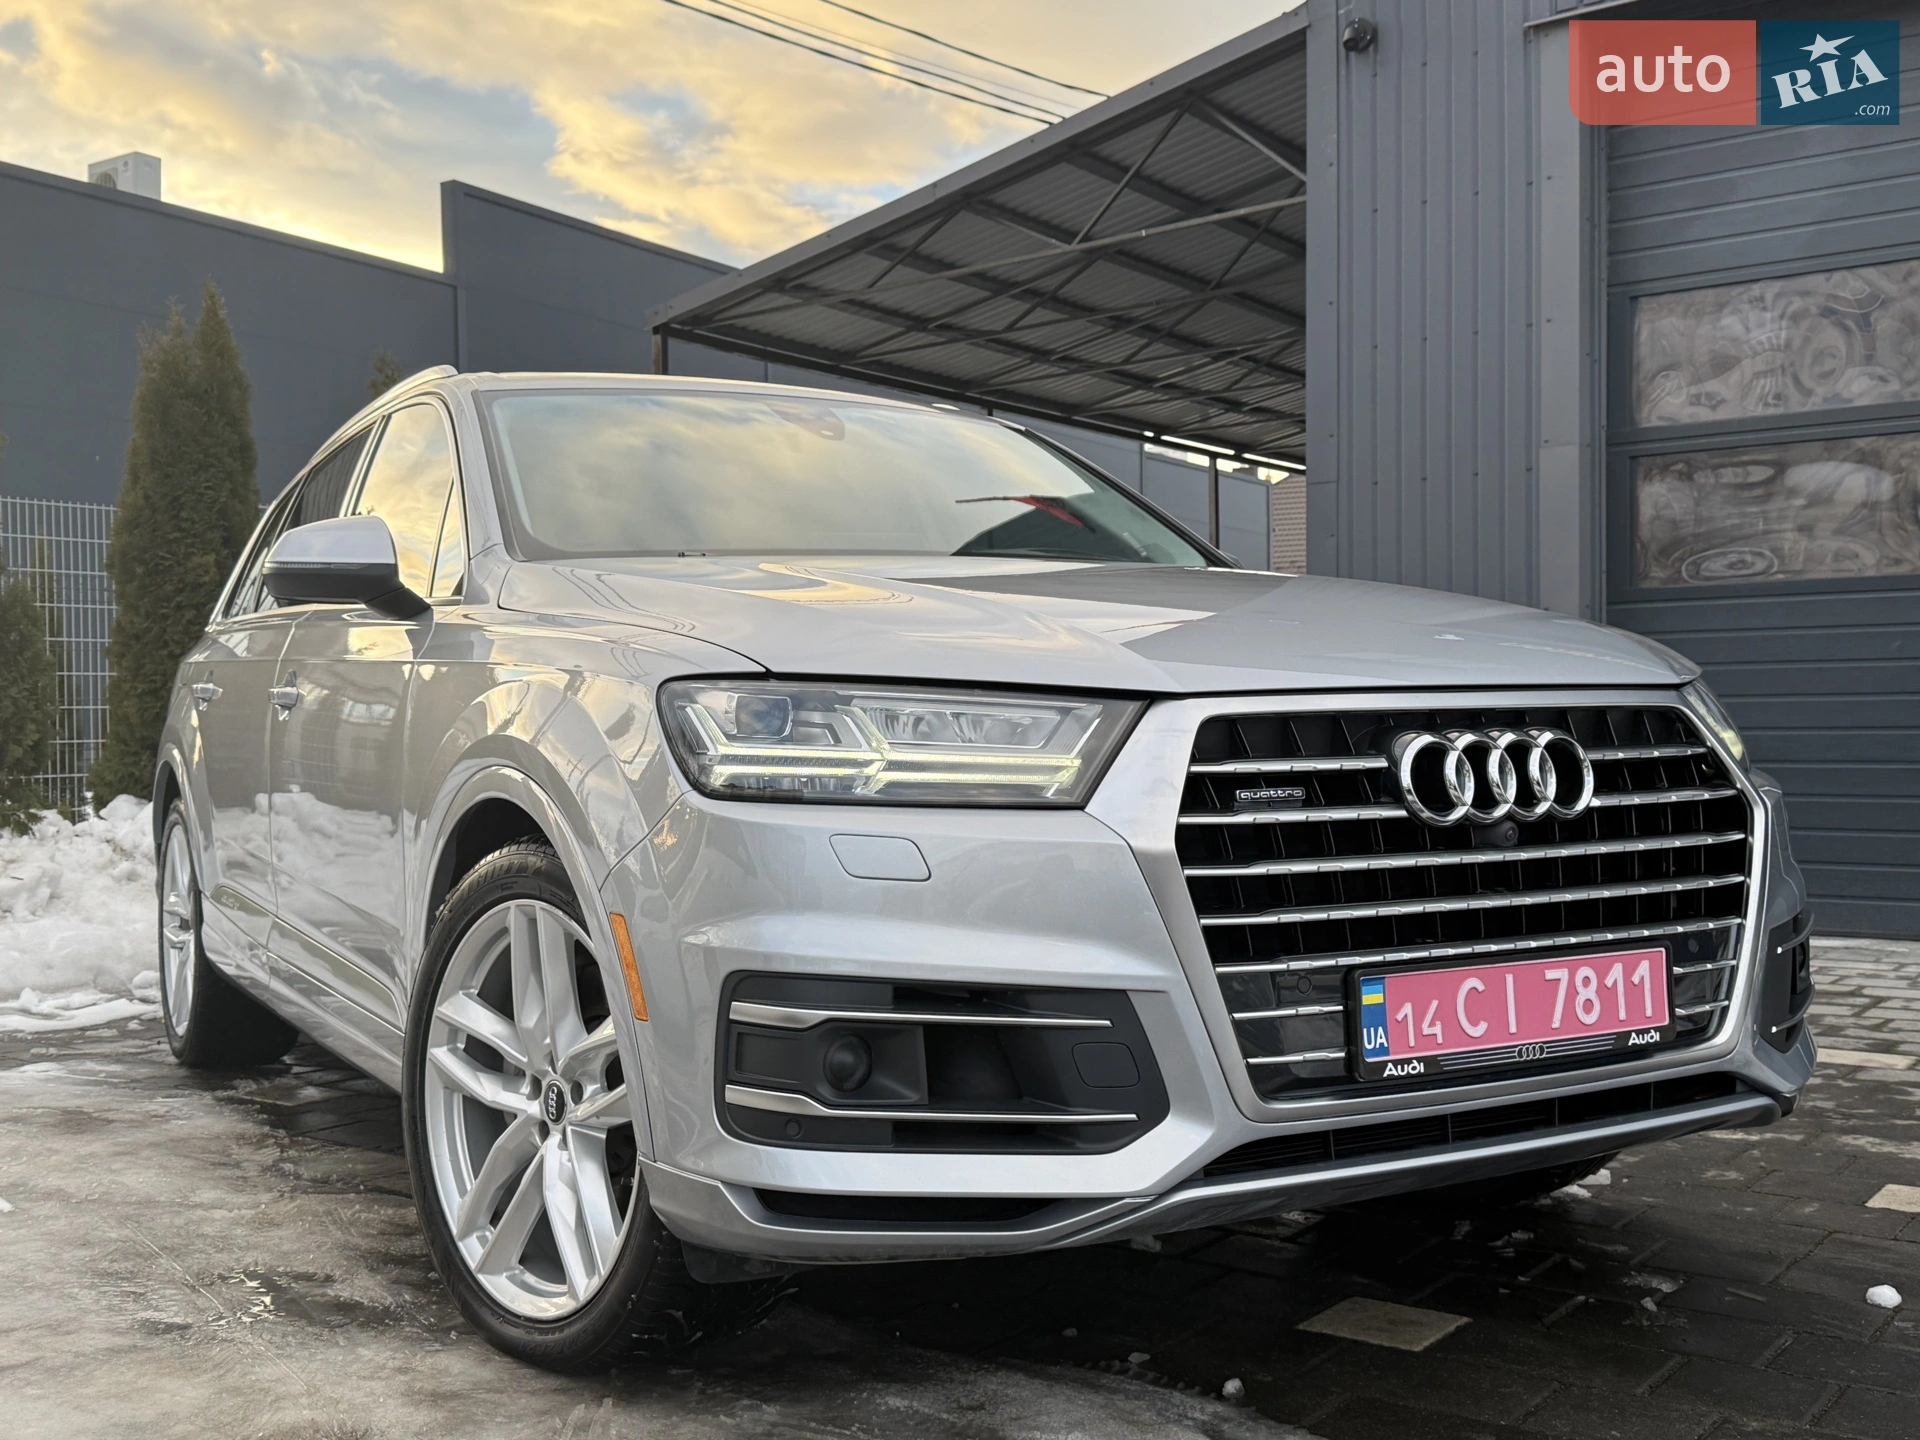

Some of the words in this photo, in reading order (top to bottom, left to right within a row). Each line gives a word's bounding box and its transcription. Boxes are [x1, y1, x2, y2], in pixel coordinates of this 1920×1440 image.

[1240, 789, 1303, 800] quattro
[1544, 959, 1653, 1029] 7811
[1362, 1026, 1389, 1050] UA
[1627, 1029, 1661, 1046] Audi
[1382, 1059, 1425, 1077] Audi
